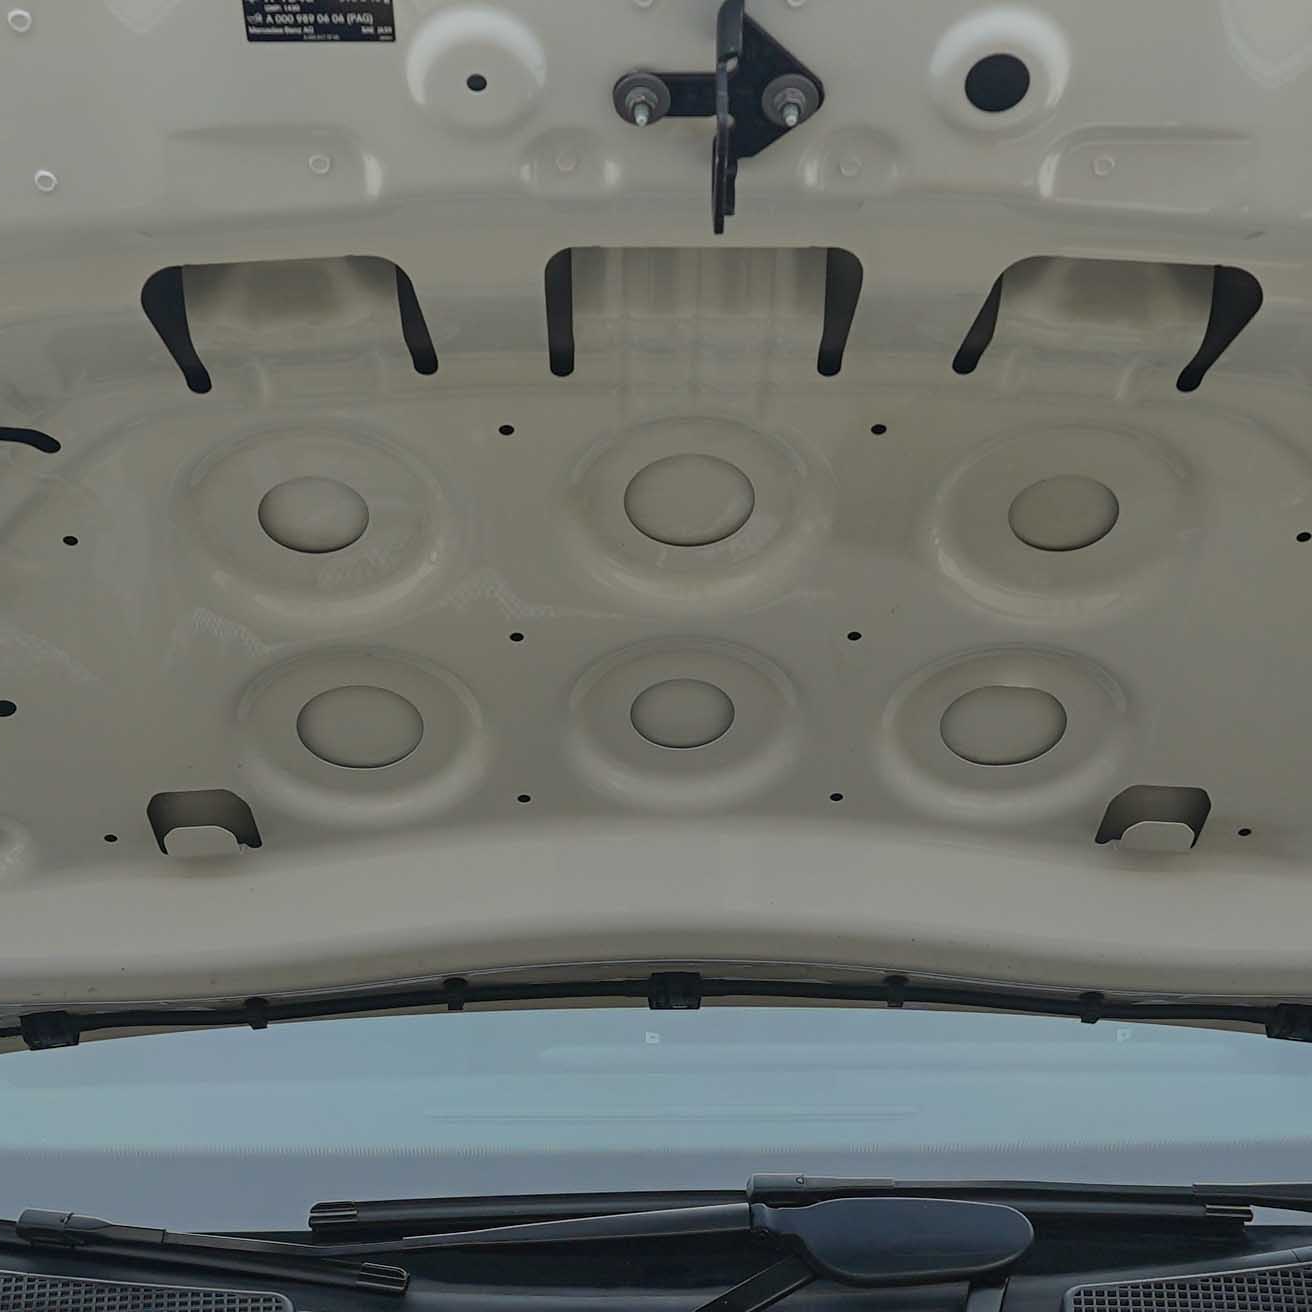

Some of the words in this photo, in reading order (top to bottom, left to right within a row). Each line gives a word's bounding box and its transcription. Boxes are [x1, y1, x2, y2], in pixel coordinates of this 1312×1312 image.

[266, 13, 275, 24] A
[275, 13, 294, 25] 000
[347, 12, 373, 25] (PAG)
